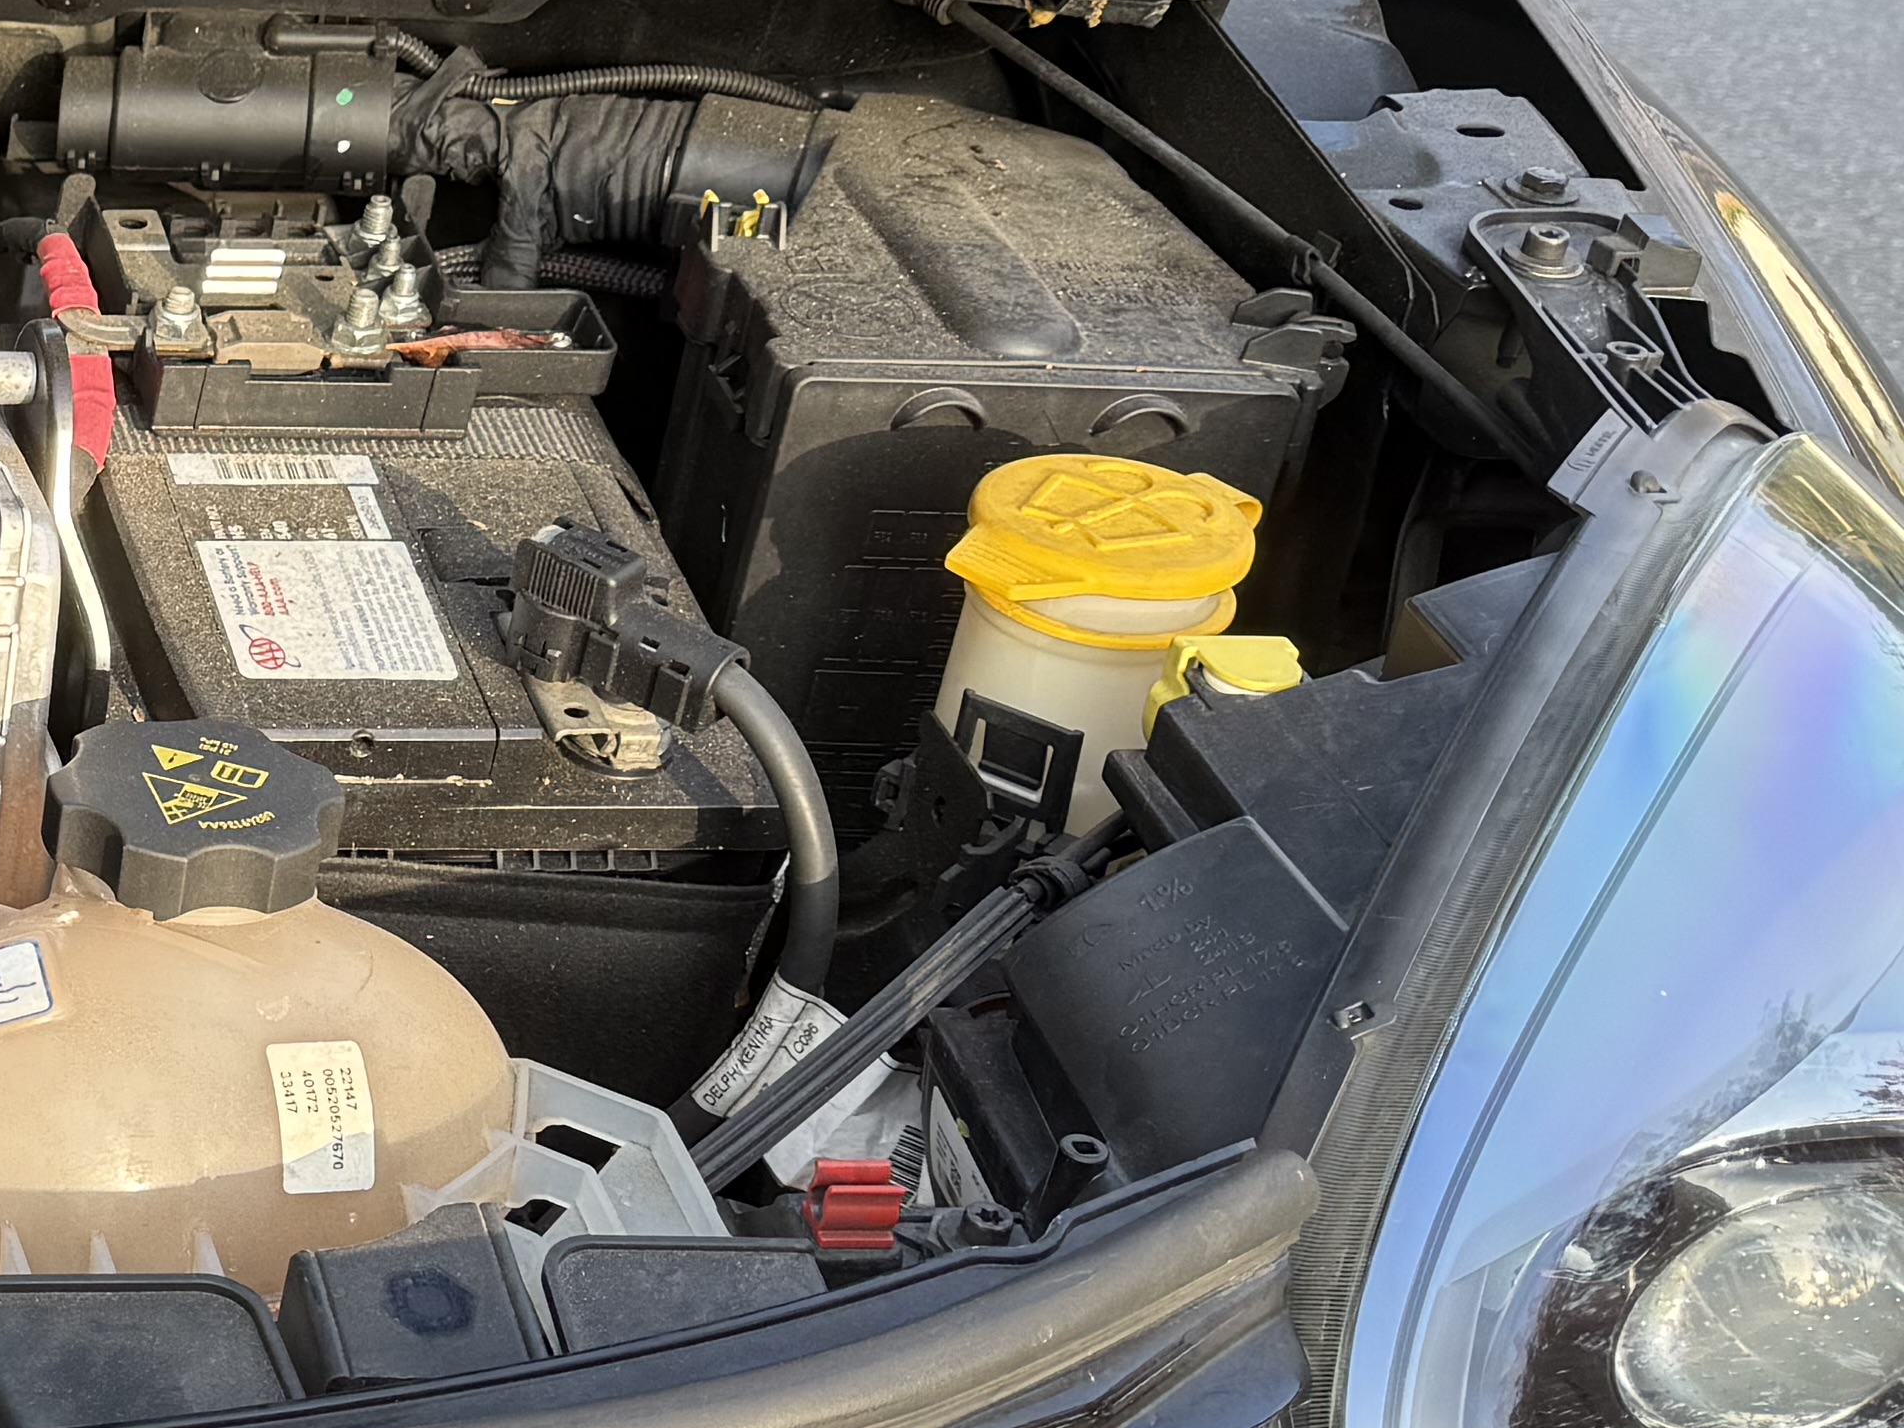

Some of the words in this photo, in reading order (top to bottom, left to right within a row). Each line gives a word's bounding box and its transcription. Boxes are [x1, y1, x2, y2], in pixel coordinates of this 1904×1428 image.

[239, 581, 261, 615] Warranty
[280, 1071, 298, 1114] 33417
[302, 1070, 319, 1113] 40172
[340, 1067, 357, 1110] 22147
[323, 1068, 344, 1170] 00520527670
